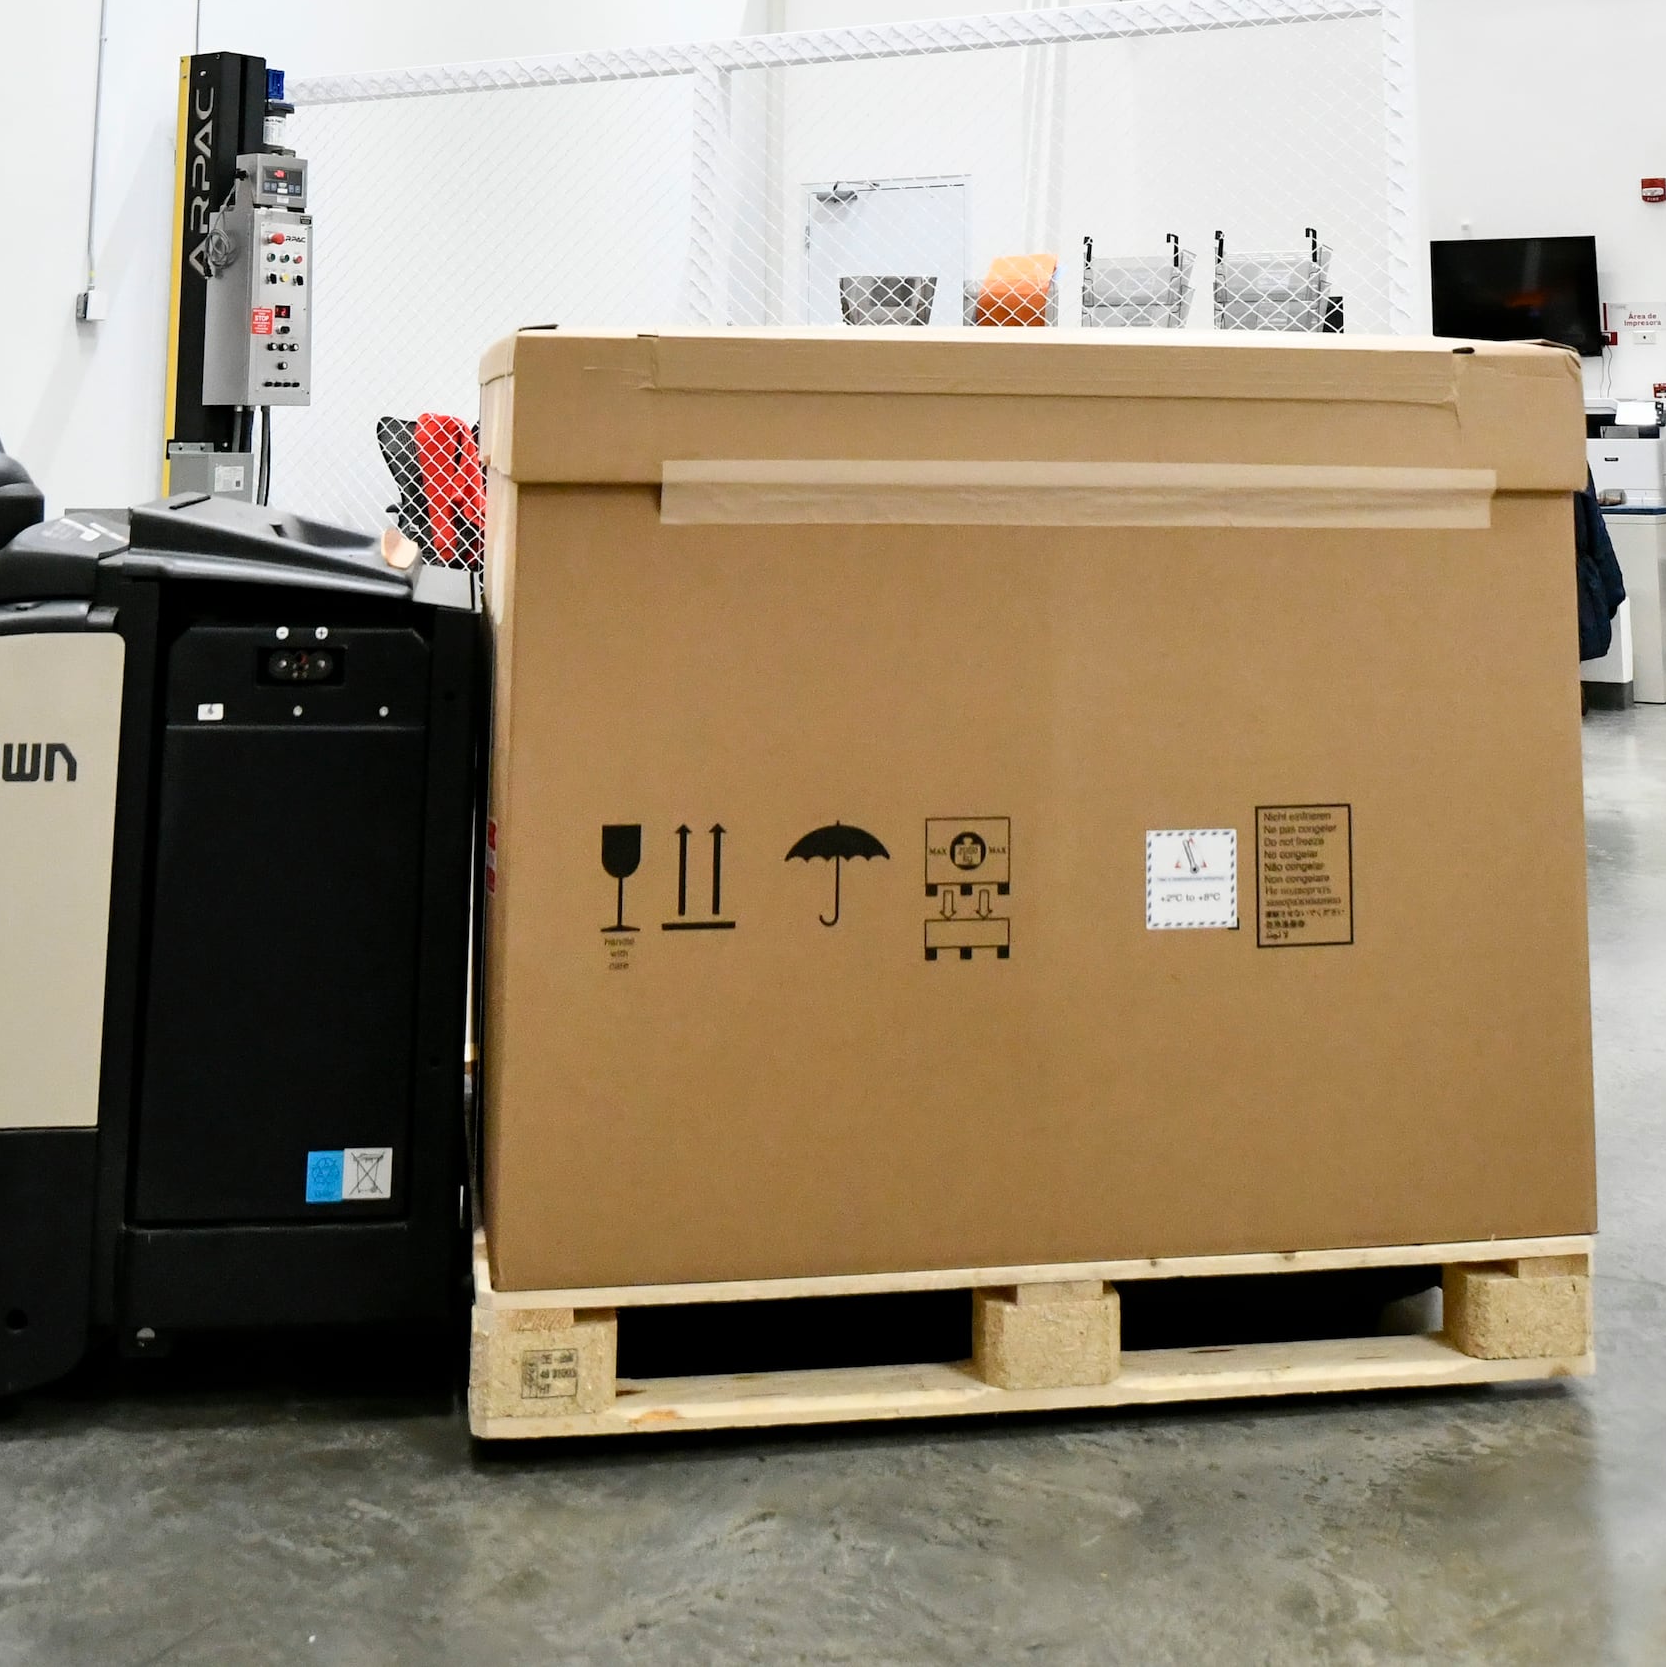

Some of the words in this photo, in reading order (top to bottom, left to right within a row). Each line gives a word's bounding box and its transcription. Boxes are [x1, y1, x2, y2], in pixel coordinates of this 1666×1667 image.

[189, 87, 215, 278] ARPAC
[1628, 310, 1646, 320] Área
[1623, 319, 1662, 327] Impresora
[1263, 811, 1287, 821] Nicht
[1263, 825, 1277, 834] Ne
[1279, 824, 1296, 835] pas
[1298, 824, 1337, 834] congeler
[1263, 837, 1277, 847] Do
[1279, 837, 1294, 846] not
[1295, 837, 1325, 846] freeze
[929, 846, 947, 855] MAX
[989, 846, 1007, 855] MAX
[1264, 850, 1277, 859] No
[1279, 850, 1318, 861] congelar
[1264, 862, 1283, 872] Não
[1284, 862, 1326, 873] congelar
[1264, 875, 1284, 884] Non
[1285, 875, 1330, 885] congelare
[1185, 893, 1195, 902] to
[610, 949, 629, 959] with
[608, 962, 630, 971] care
